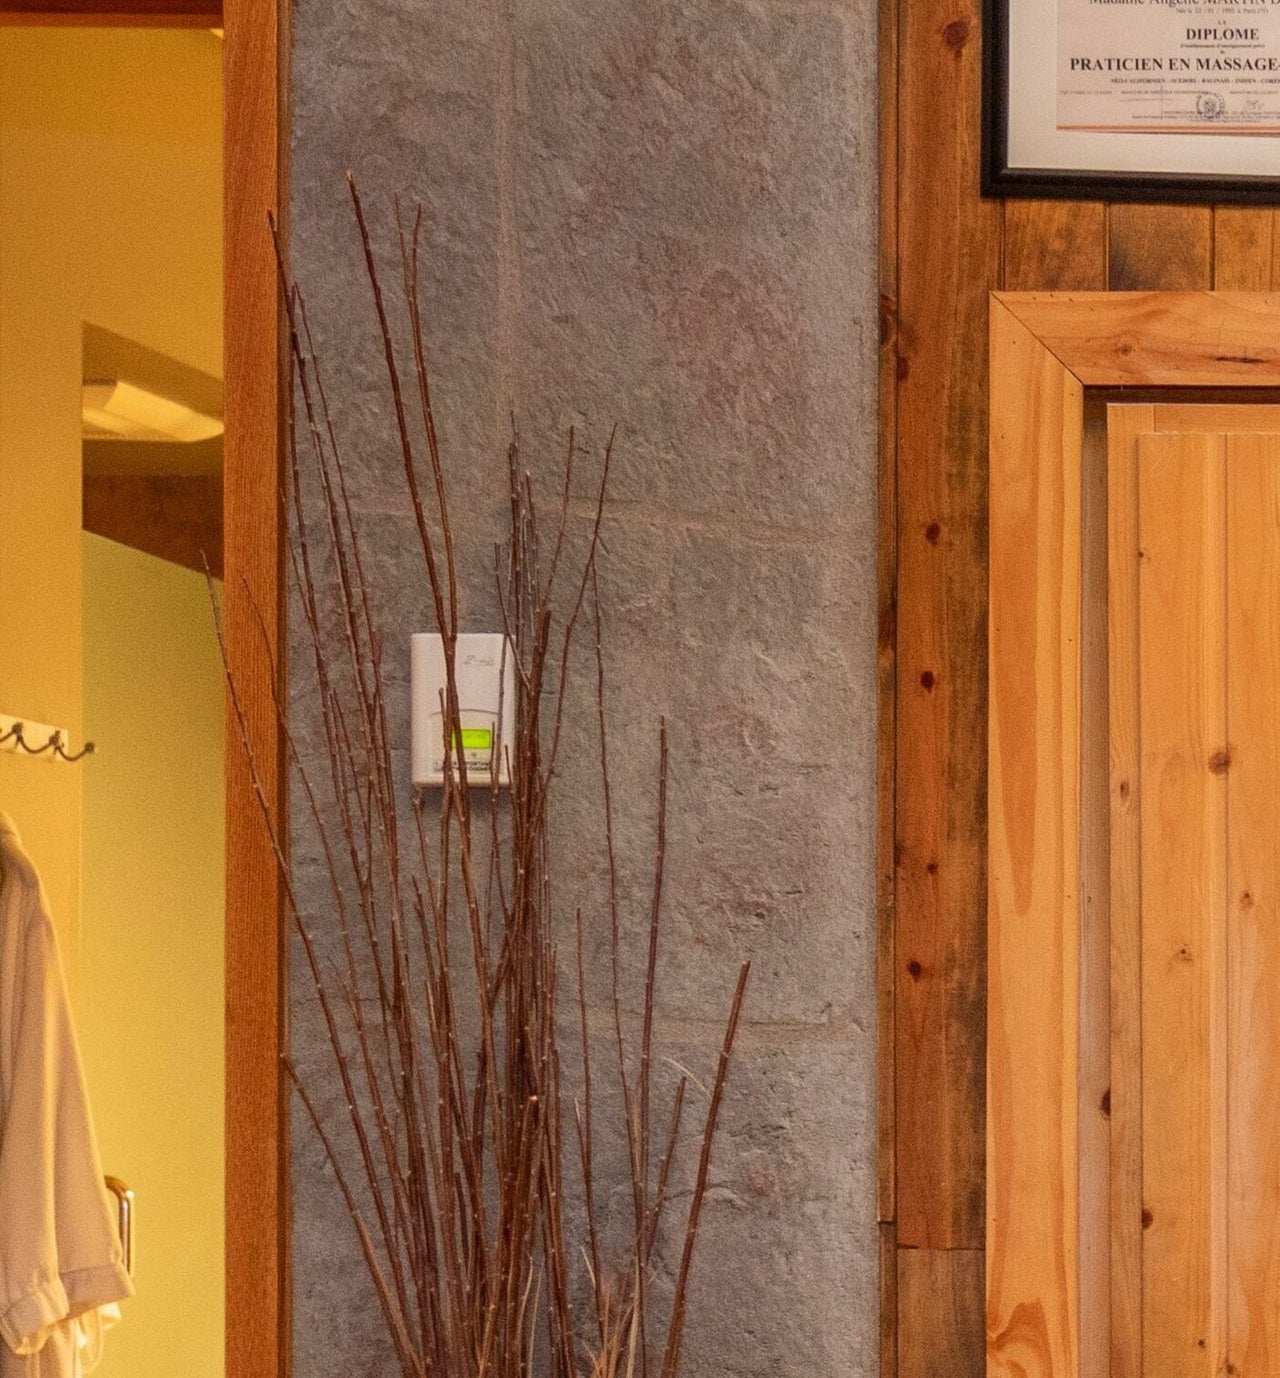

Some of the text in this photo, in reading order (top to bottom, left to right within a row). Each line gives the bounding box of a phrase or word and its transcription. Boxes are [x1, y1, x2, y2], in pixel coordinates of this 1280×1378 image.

[1186, 28, 1259, 40] DIPLOME
[1070, 58, 1163, 71] PRATICIEN
[1168, 58, 1191, 71] EN
